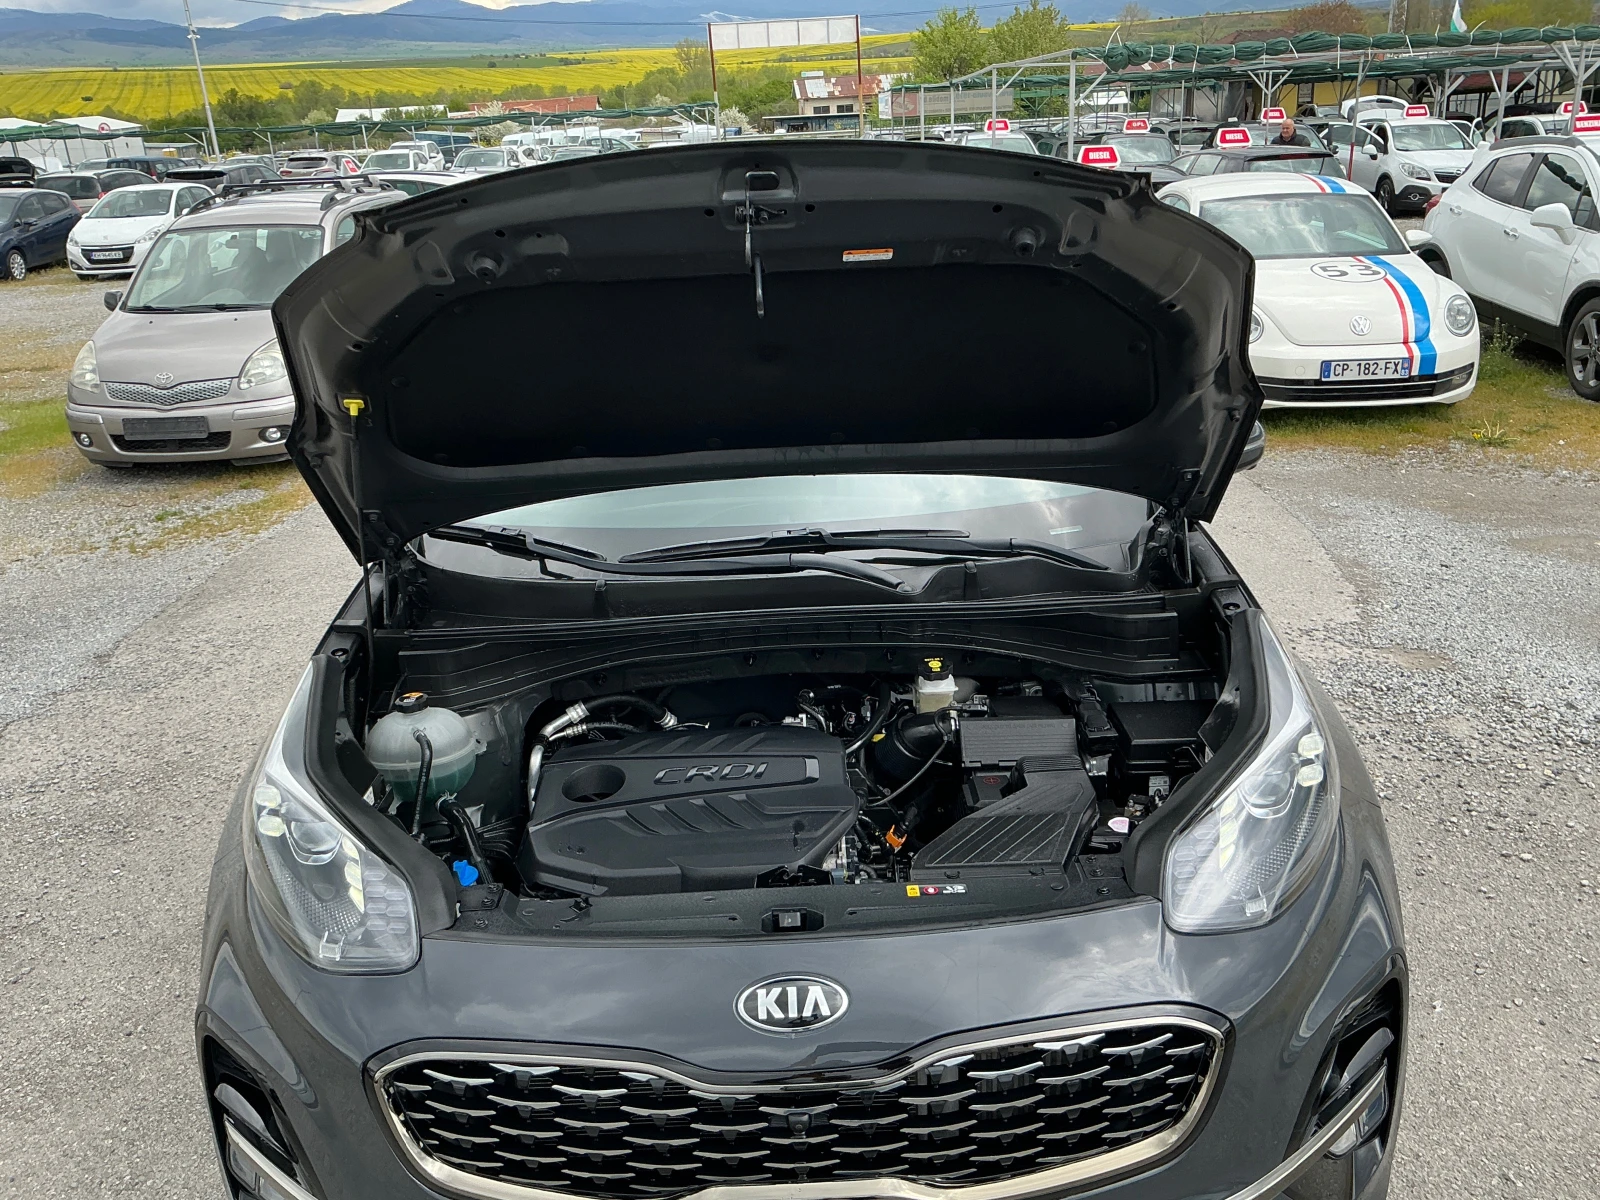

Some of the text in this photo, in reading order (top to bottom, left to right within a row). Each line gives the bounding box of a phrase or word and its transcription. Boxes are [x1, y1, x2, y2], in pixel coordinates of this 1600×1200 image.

[1225, 132, 1244, 140] DIESEL
[1088, 151, 1111, 160] DIESEL
[1318, 264, 1382, 277] 53
[1333, 361, 1400, 377] CP-182-FX
[653, 762, 769, 785] CRDI
[756, 985, 831, 1020] KIA
